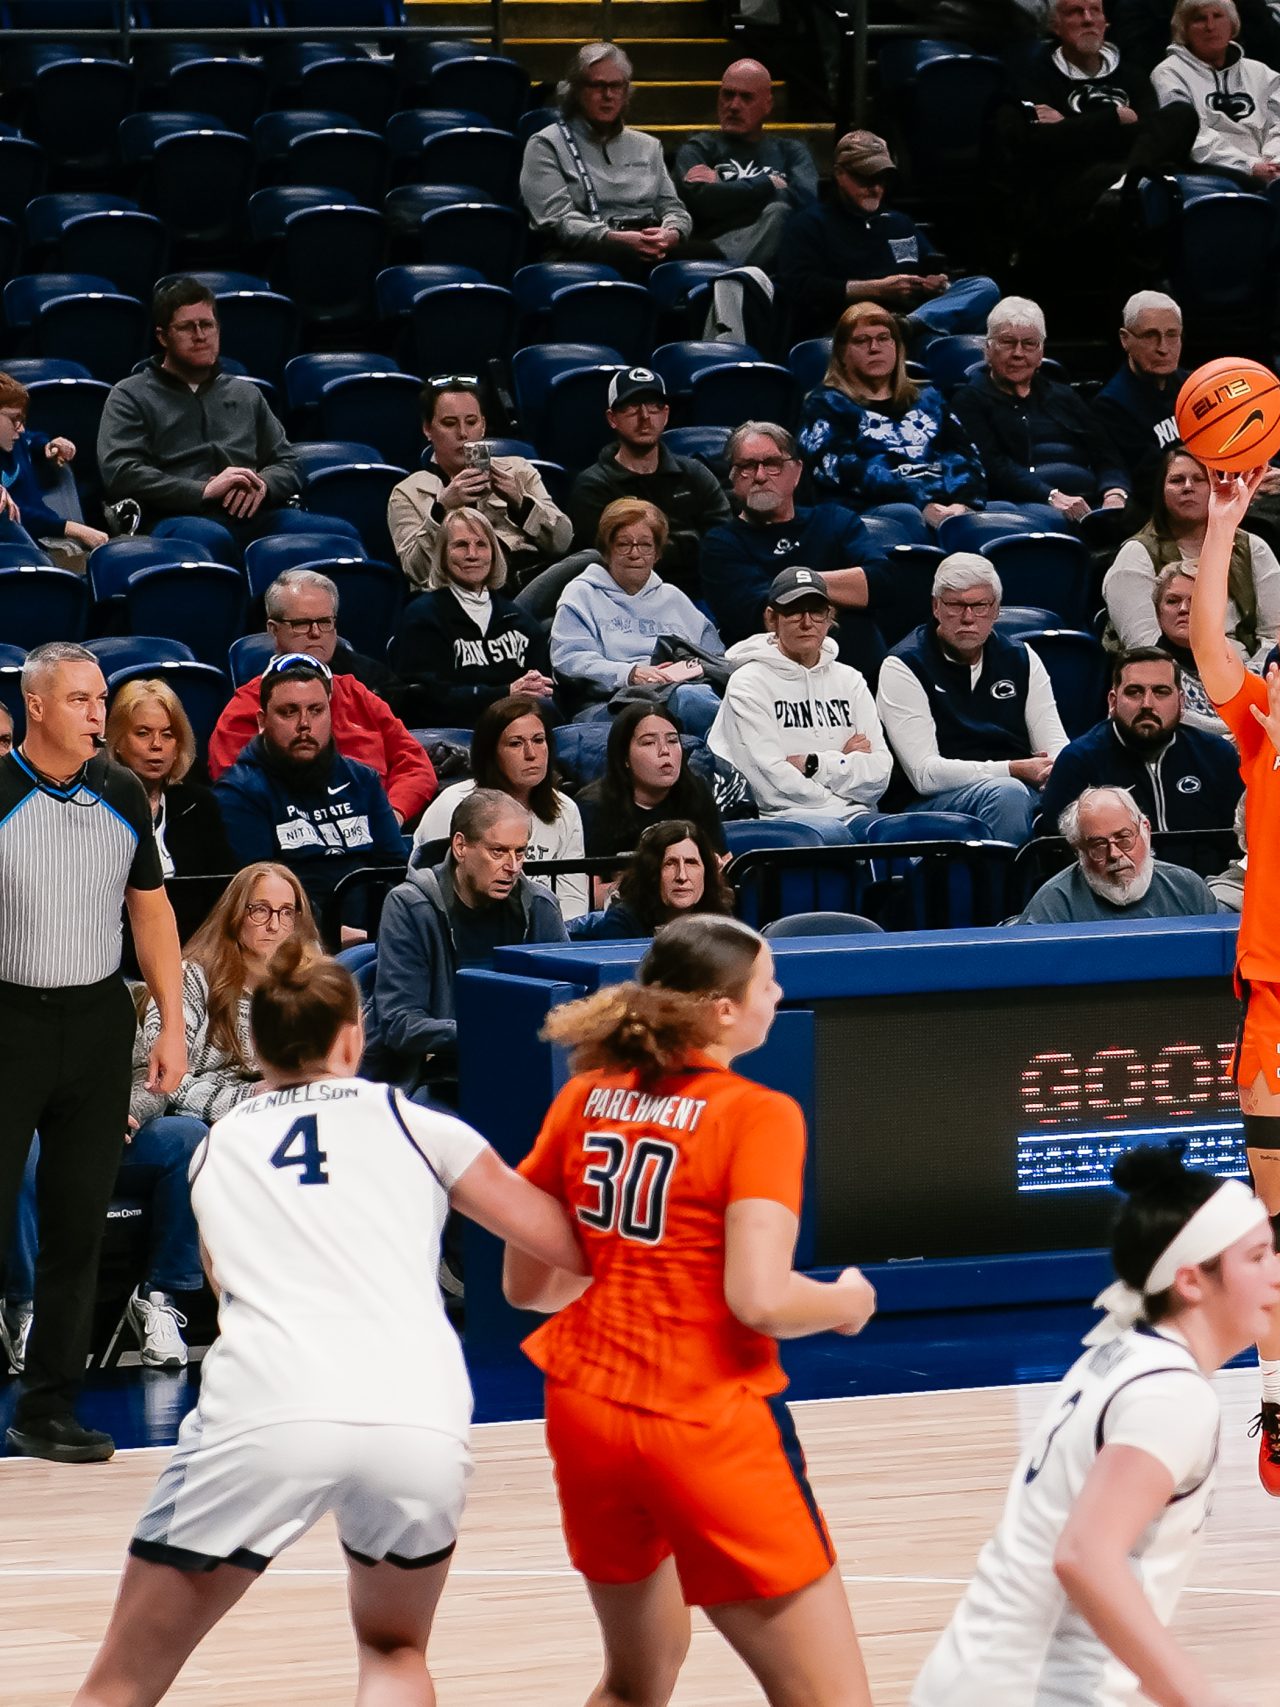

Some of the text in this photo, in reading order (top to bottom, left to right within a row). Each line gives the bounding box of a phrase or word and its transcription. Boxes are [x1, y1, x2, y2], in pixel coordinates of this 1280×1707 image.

[795, 571, 813, 584] S
[774, 700, 854, 729] PENN STATE
[236, 1083, 360, 1117] MENDELSON
[583, 1087, 708, 1133] PARCHMENT
[268, 1112, 329, 1186] 4
[575, 1131, 679, 1247] 30
